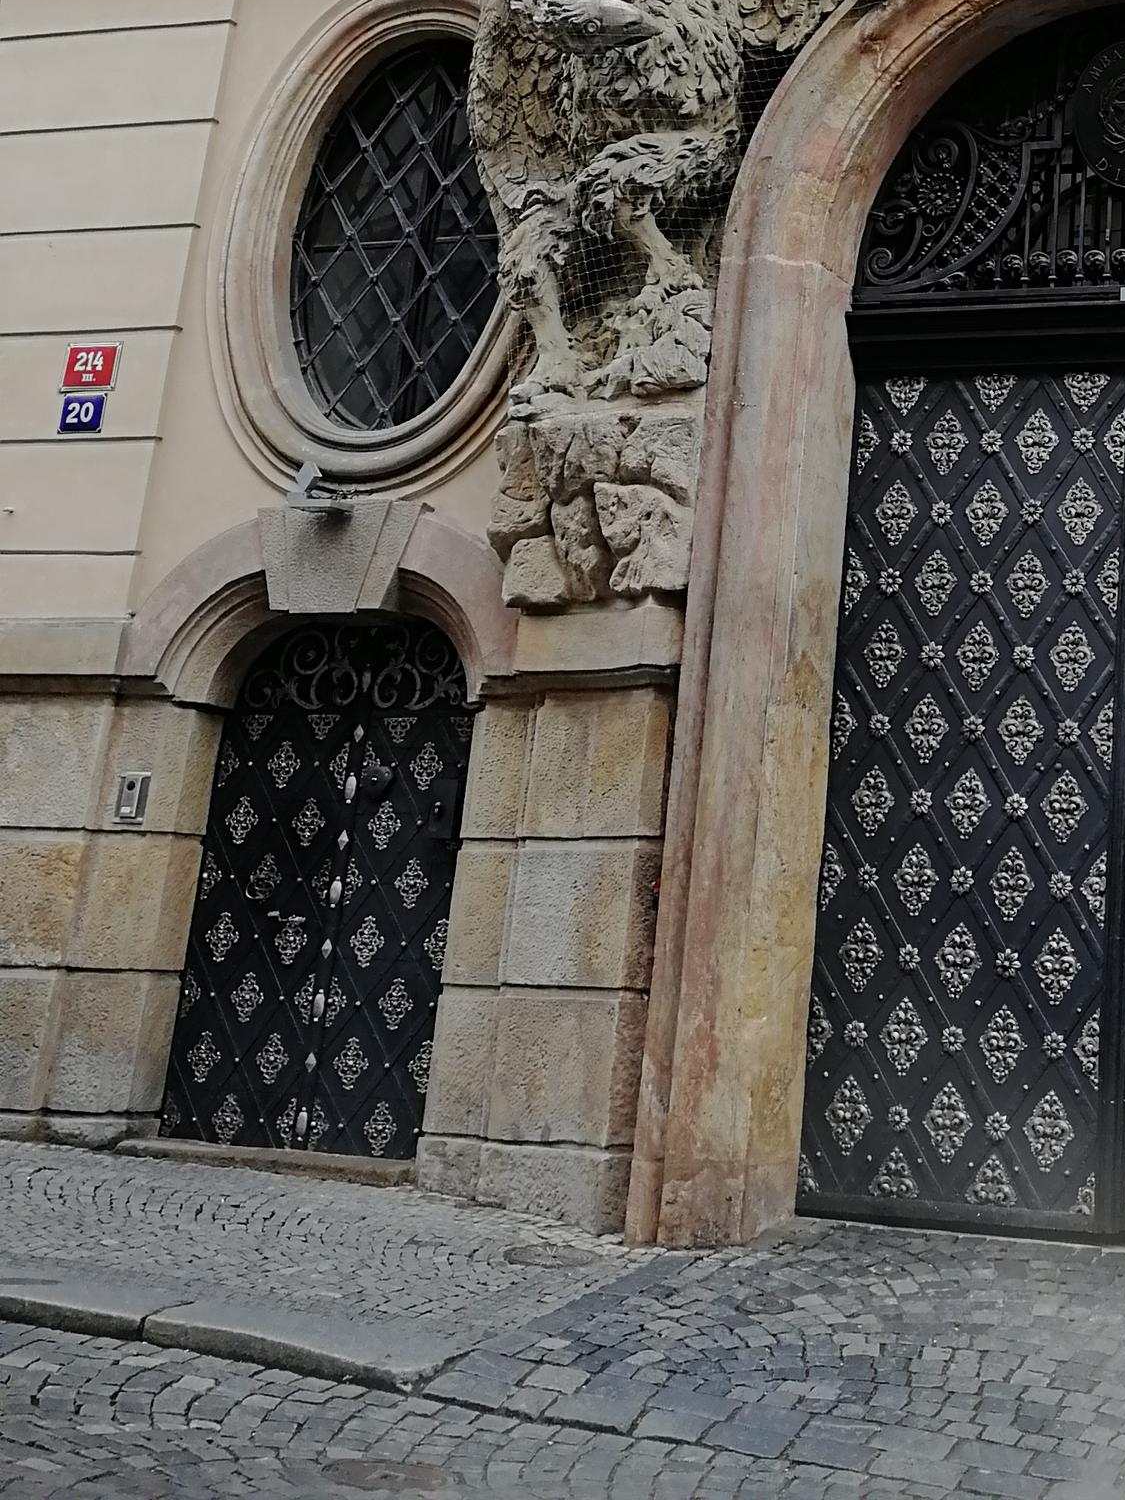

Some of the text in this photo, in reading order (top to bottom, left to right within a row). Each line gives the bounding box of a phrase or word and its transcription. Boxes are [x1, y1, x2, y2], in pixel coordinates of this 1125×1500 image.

[74, 351, 104, 371] 214
[81, 373, 96, 382] III.
[65, 402, 94, 423] 20
